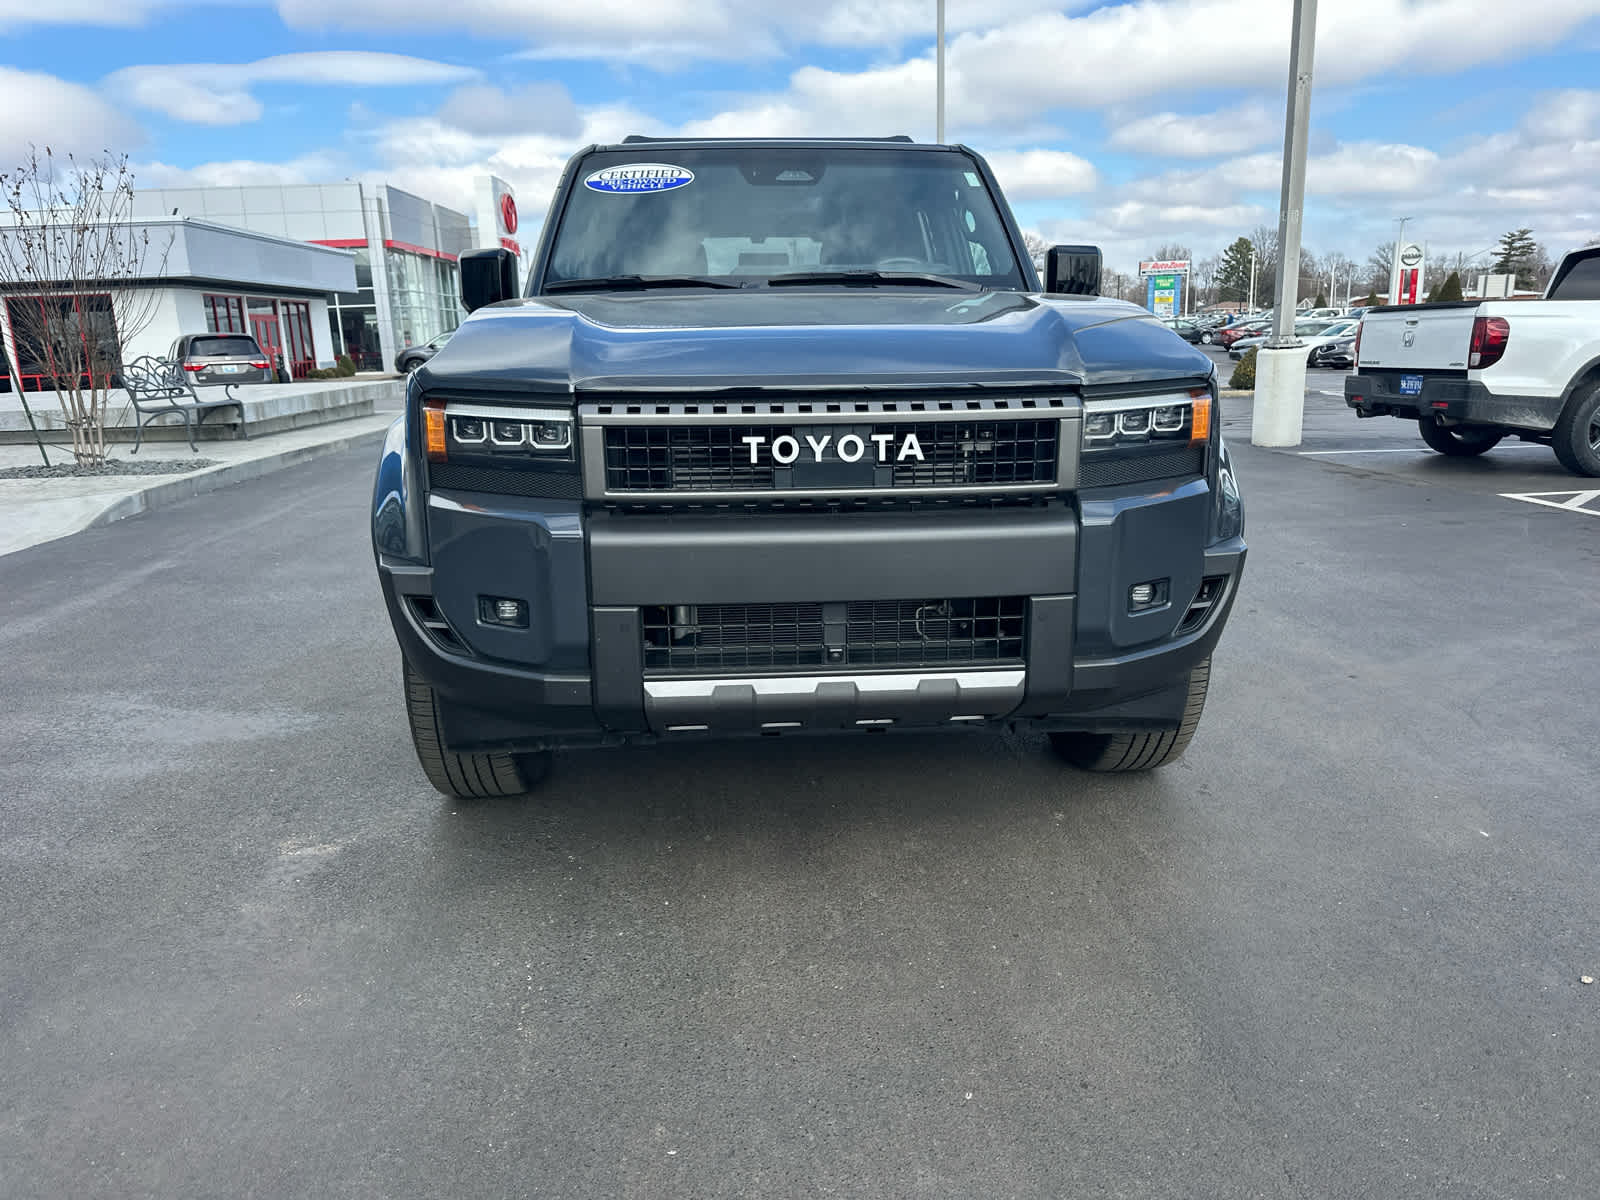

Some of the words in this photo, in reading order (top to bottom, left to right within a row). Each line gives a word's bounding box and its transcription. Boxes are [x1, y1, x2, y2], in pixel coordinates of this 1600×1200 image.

[599, 169, 682, 180] CERTIFIED
[600, 177, 677, 186] PRE-OWNED
[742, 434, 925, 464] TOYOTA
